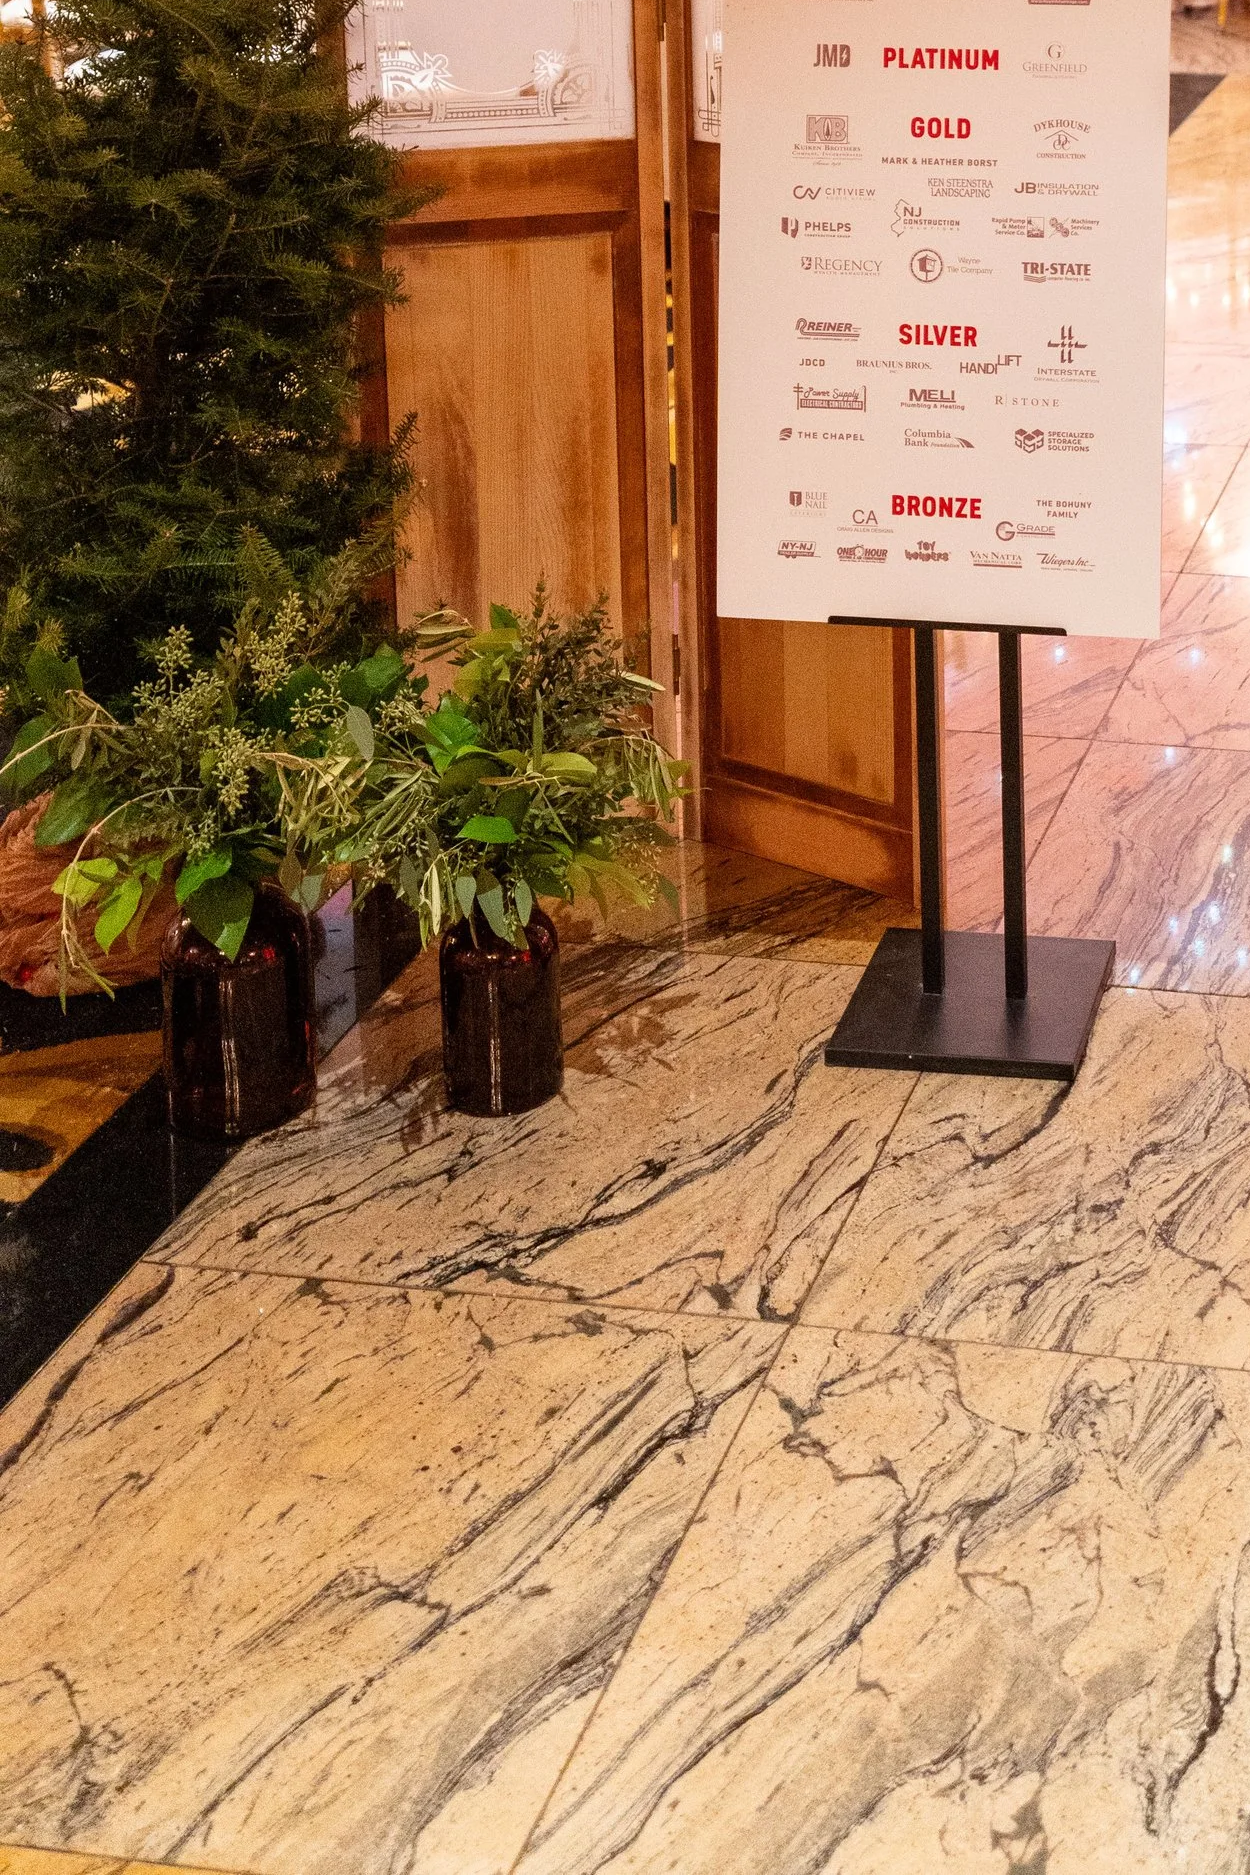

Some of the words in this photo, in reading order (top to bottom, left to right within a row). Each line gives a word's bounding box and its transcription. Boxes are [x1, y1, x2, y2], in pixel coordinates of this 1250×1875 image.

[814, 44, 850, 68] JMD
[883, 47, 1000, 71] PLATINUM
[910, 116, 971, 139] GOLD
[1033, 119, 1091, 134] DYKHOUSE
[881, 156, 909, 165] MARK
[912, 157, 918, 165] &
[921, 157, 964, 166] HEATHER
[967, 159, 998, 167] BORST
[1036, 152, 1087, 160] CONSTRUCTION
[928, 177, 945, 187] KEN
[946, 178, 994, 189] STEENSTRA
[1014, 181, 1036, 195] JB
[825, 187, 876, 197] CITIVIEW
[931, 188, 991, 199] LANDSCAPING
[903, 206, 922, 218] NJ
[804, 221, 852, 232] PHELPS
[814, 256, 883, 272] REGENCY
[1022, 261, 1091, 276] TRI-STATE
[807, 321, 853, 332] REINER
[899, 323, 978, 347] SILVER
[800, 358, 825, 367] JDCD
[1037, 367, 1097, 377] INTERSTATE
[909, 388, 955, 402] MELI
[797, 431, 818, 440] THE
[823, 432, 865, 442] CHAPEL
[904, 428, 951, 439] Columbia
[1047, 430, 1095, 439] SPECIALIZED
[904, 438, 929, 448] Bank
[1047, 438, 1082, 446] STORAGE
[1047, 444, 1090, 453] SOLUTIONS
[805, 491, 828, 500] BLUE
[805, 500, 827, 509] NAIL
[891, 494, 982, 519] BRONZE
[1037, 499, 1053, 508] THE
[1056, 500, 1092, 509] BOHUNY
[1047, 510, 1078, 519] FAMILY
[1017, 523, 1056, 533] GRADE
[781, 541, 813, 551] NY-NJ
[864, 547, 888, 558] HOUR
